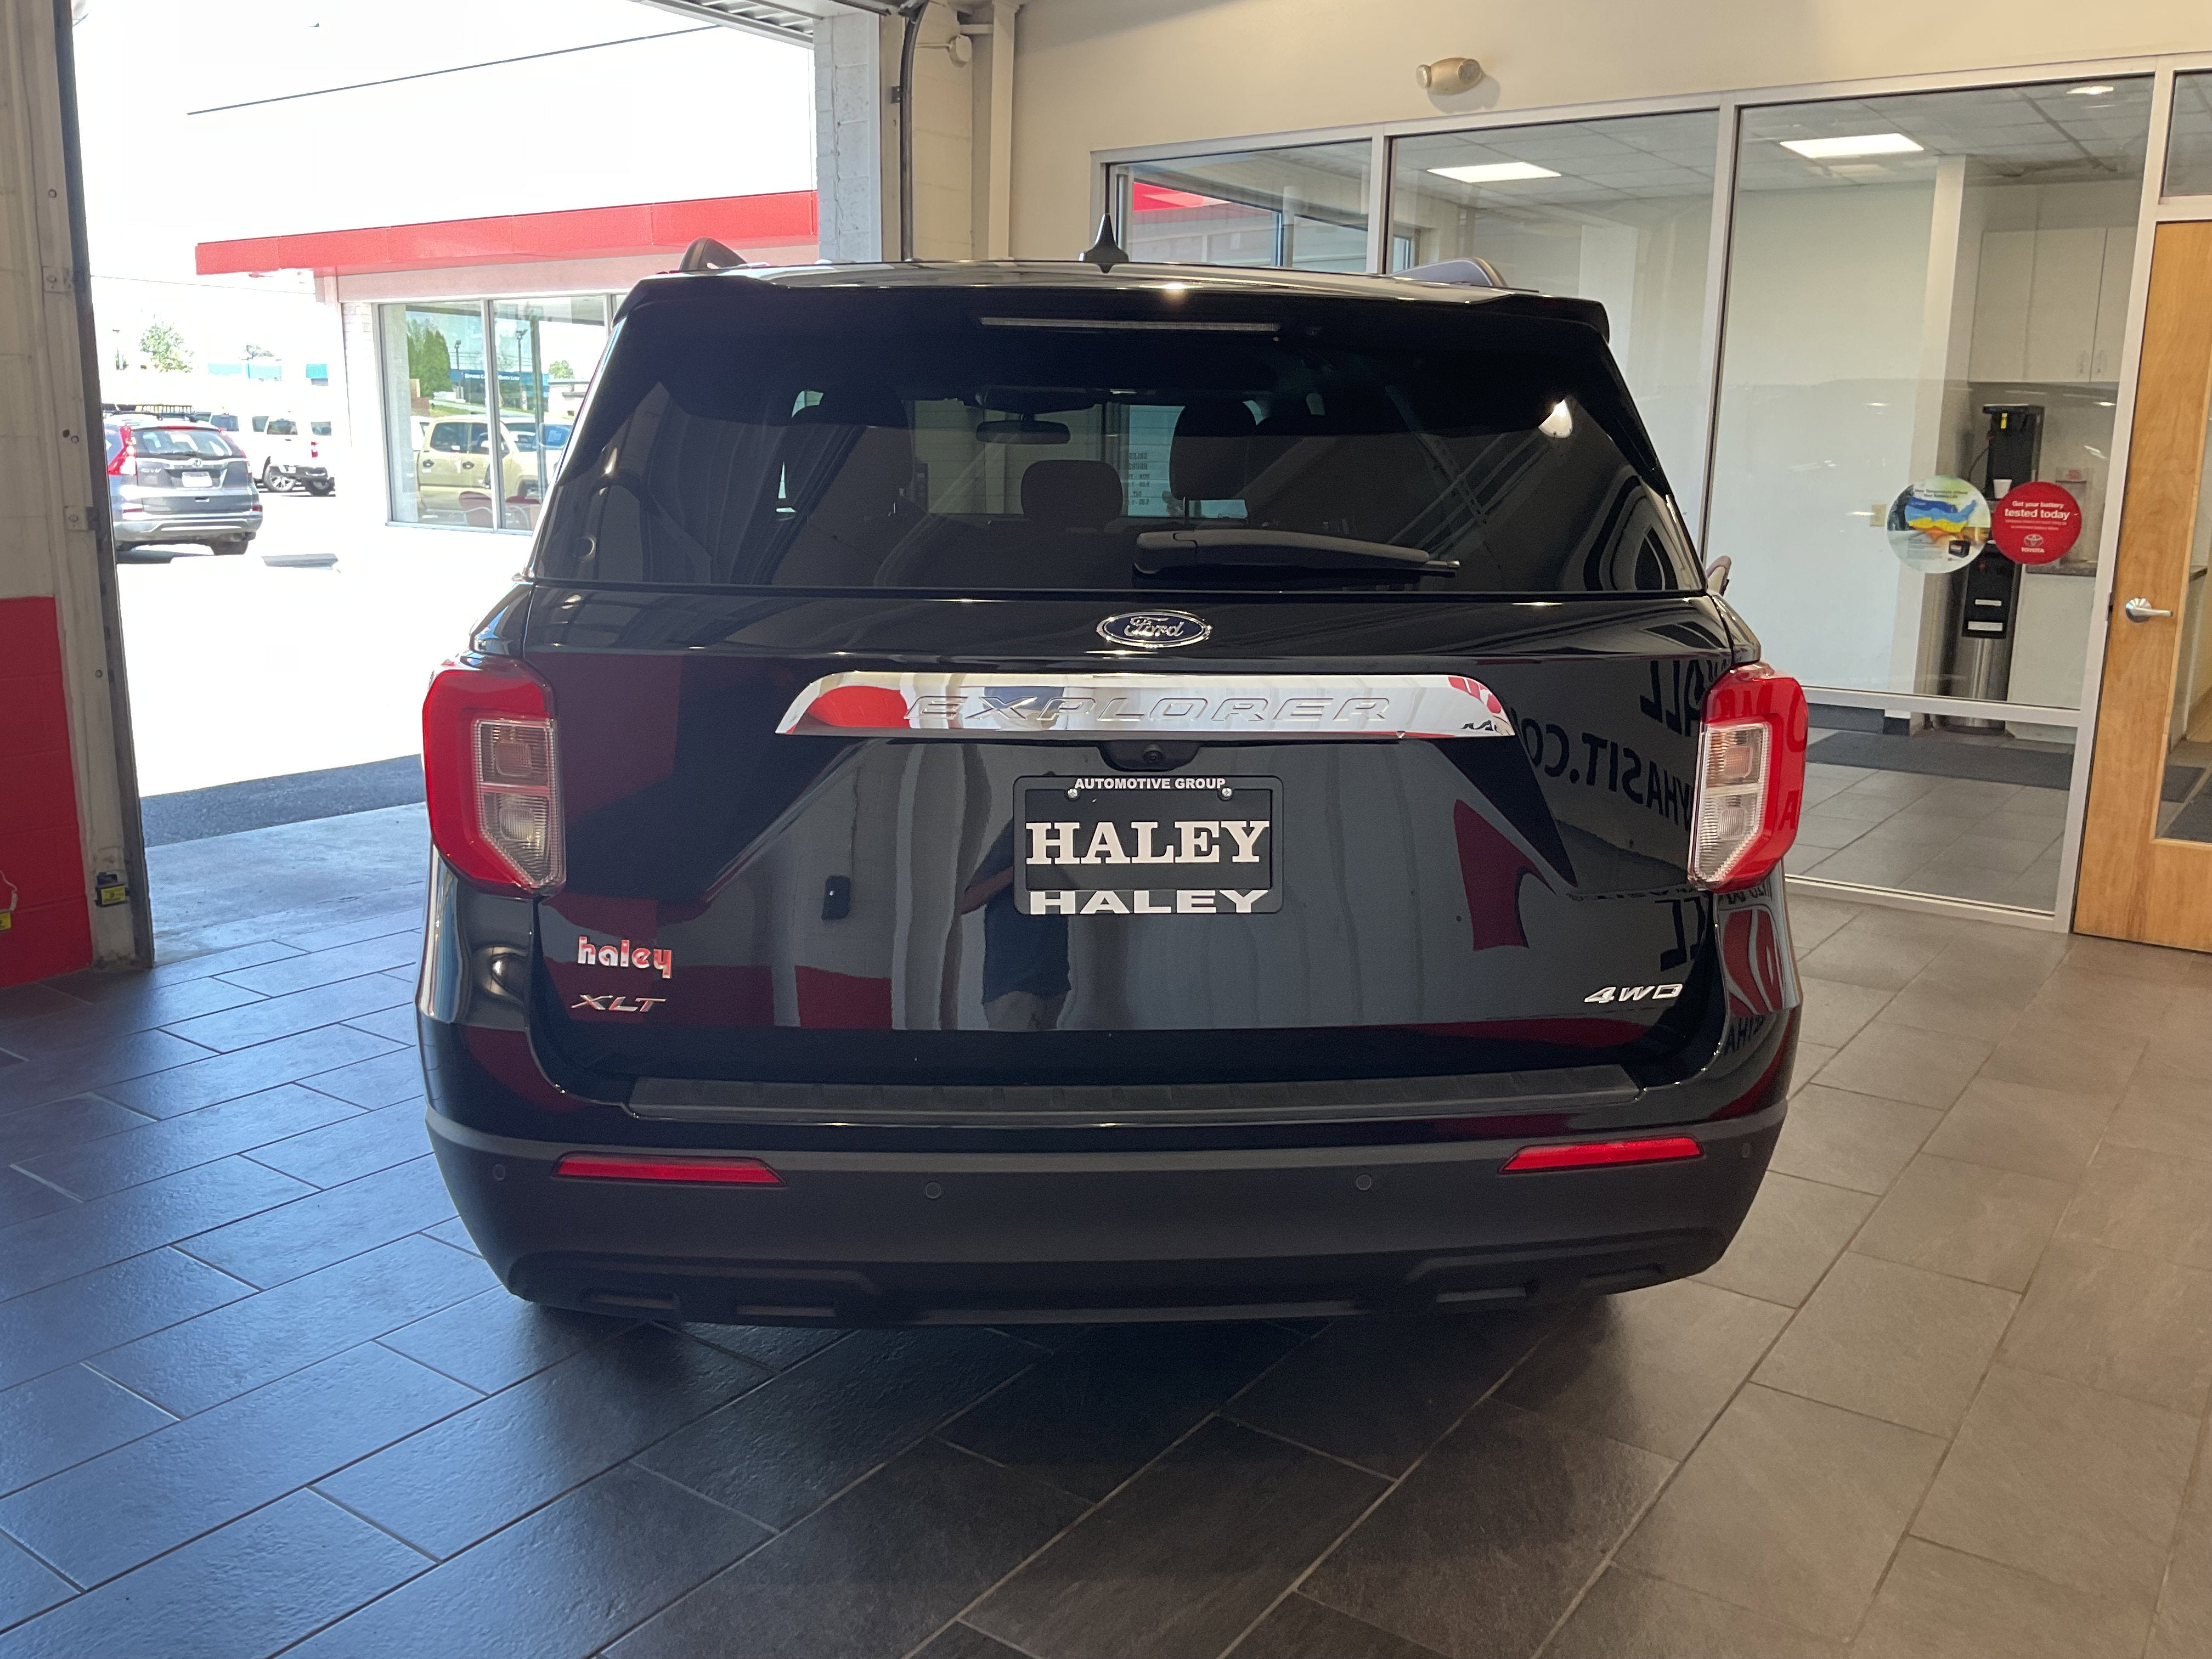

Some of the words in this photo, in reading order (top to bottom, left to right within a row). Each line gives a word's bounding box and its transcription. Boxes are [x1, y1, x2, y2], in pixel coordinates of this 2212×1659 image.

[2005, 509, 2038, 517] tested
[2040, 510, 2070, 521] today
[1124, 616, 1185, 637] Ford
[904, 695, 1391, 721] EXPLORER
[1074, 777, 1170, 789] AUTOMOTIVE
[1175, 777, 1226, 789] GROUP
[1025, 820, 1269, 865] HALEY
[1030, 889, 1268, 915] HALEY
[577, 935, 672, 979] haley
[570, 994, 667, 1012] XLT
[1584, 983, 1683, 1003] 4WD
